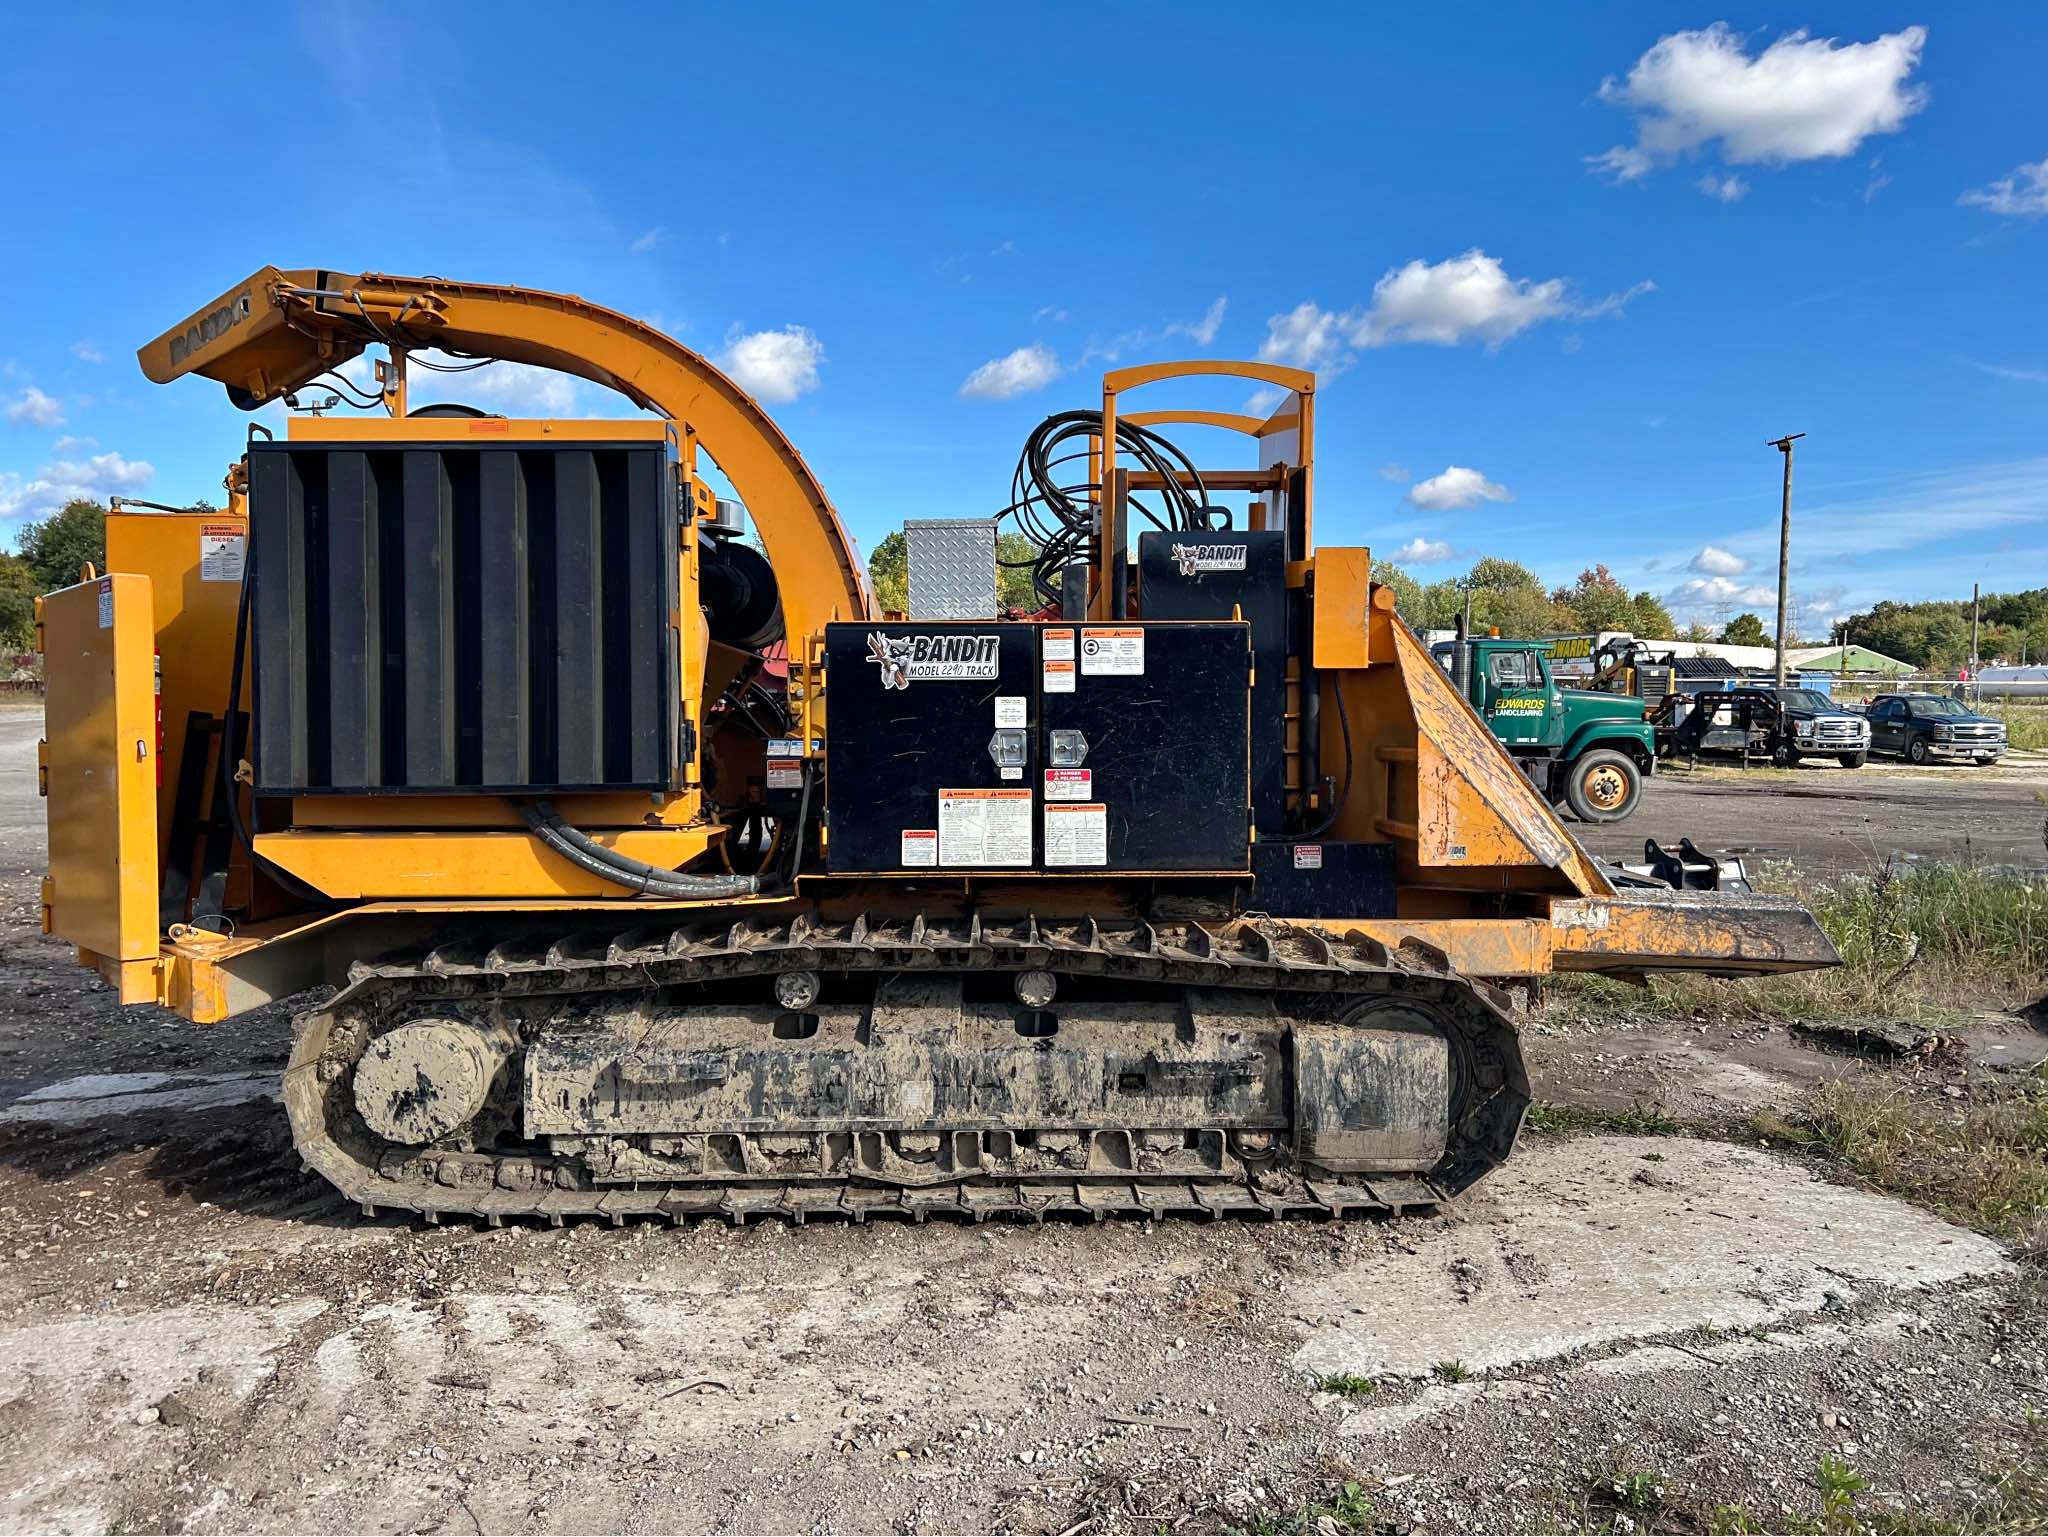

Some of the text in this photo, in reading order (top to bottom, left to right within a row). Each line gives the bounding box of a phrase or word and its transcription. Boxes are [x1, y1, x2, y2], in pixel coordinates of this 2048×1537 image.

[1197, 546, 1246, 560] BANDIT
[913, 637, 998, 662] BANDIT
[909, 664, 994, 676] MODEL 2290 TRACK
[1495, 699, 1545, 710] EDWARDS
[1496, 709, 1543, 717] LANDCLEARING
